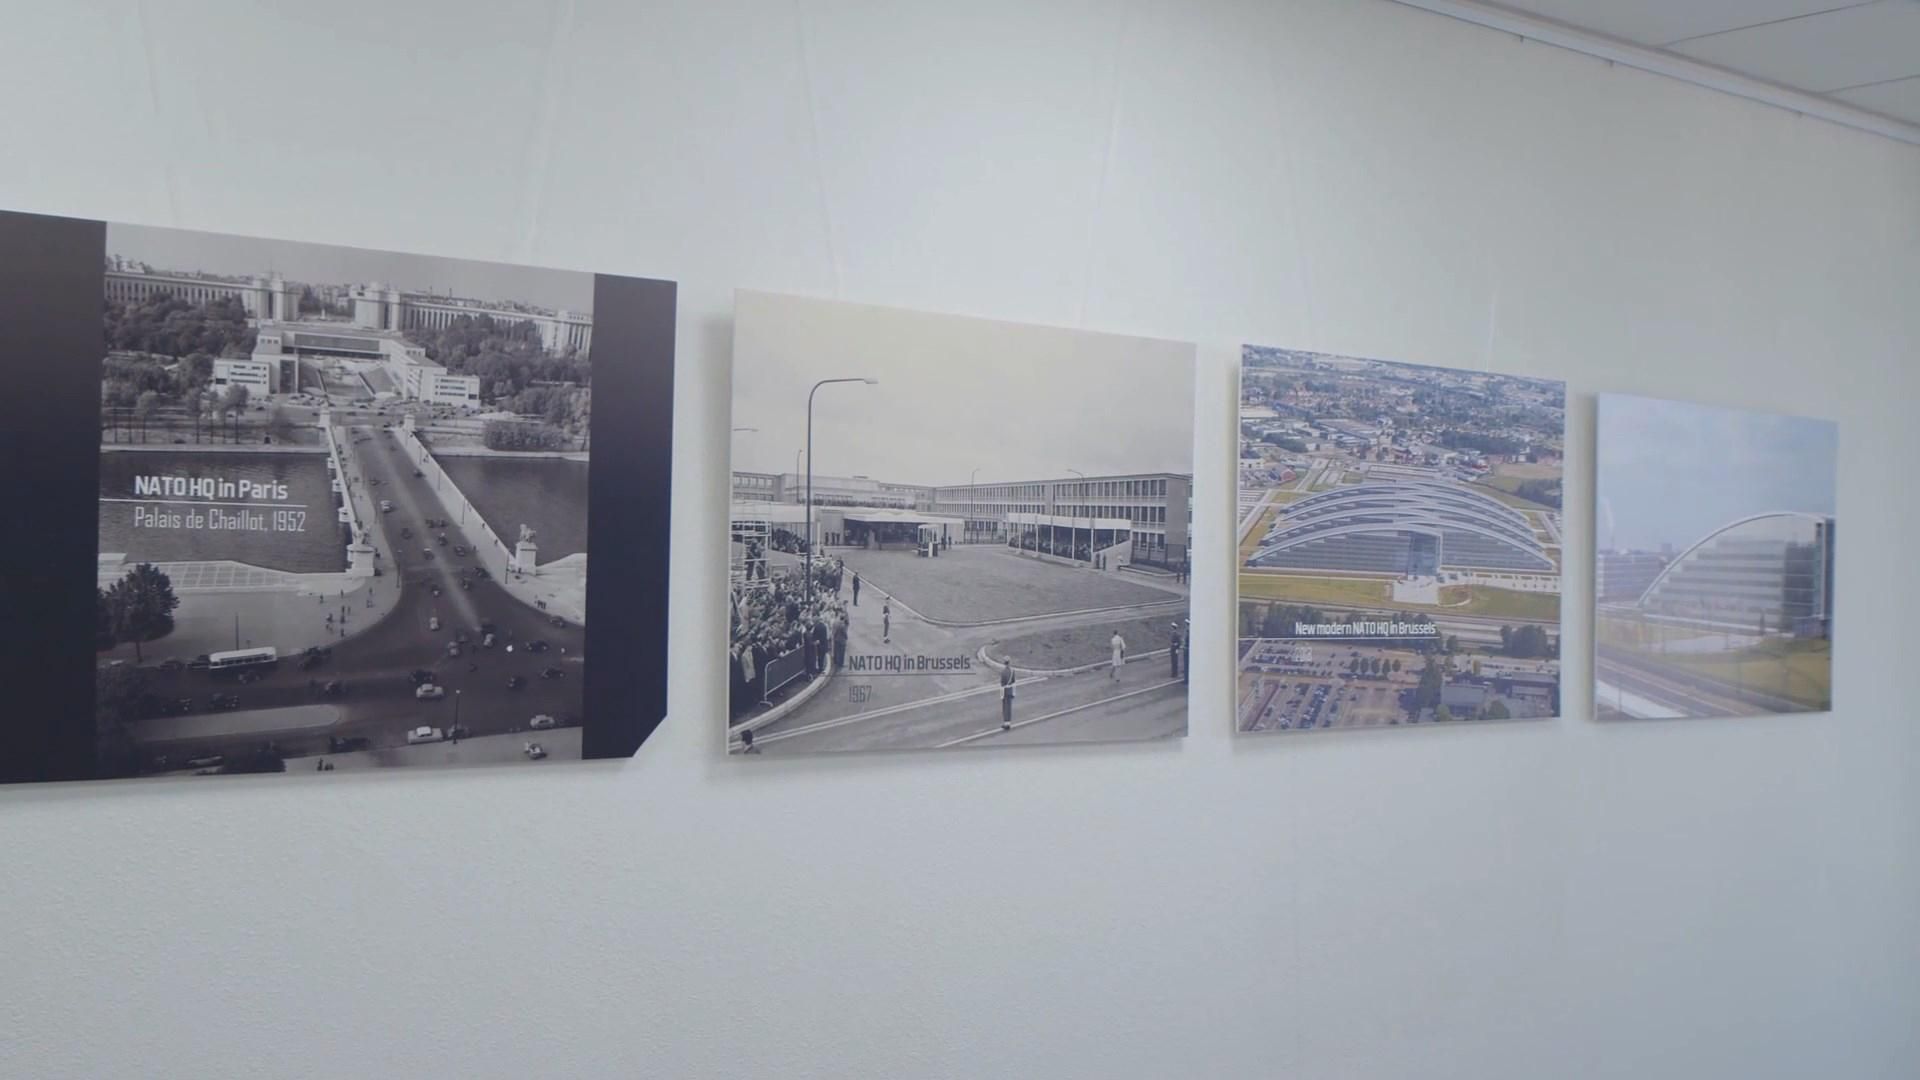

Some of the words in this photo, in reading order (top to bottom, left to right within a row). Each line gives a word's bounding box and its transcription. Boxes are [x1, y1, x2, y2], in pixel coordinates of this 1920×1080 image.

[135, 475, 186, 496] NATO
[189, 477, 215, 500] HQ
[218, 477, 235, 498] in
[238, 479, 288, 500] Paris
[134, 506, 181, 529] Palais
[185, 508, 204, 529] de
[208, 508, 268, 532] Chaillot,
[273, 510, 306, 532] 1952
[1295, 621, 1316, 635] New
[1316, 621, 1352, 635] modern
[1352, 621, 1375, 635] NATO
[1376, 621, 1389, 637] HQ
[1389, 620, 1398, 635] in
[1399, 621, 1436, 635] Brussels
[848, 655, 882, 671] NATO
[885, 655, 901, 673] HQ
[903, 653, 915, 670] in
[917, 654, 971, 670] Brussels
[848, 685, 872, 703] 1967
